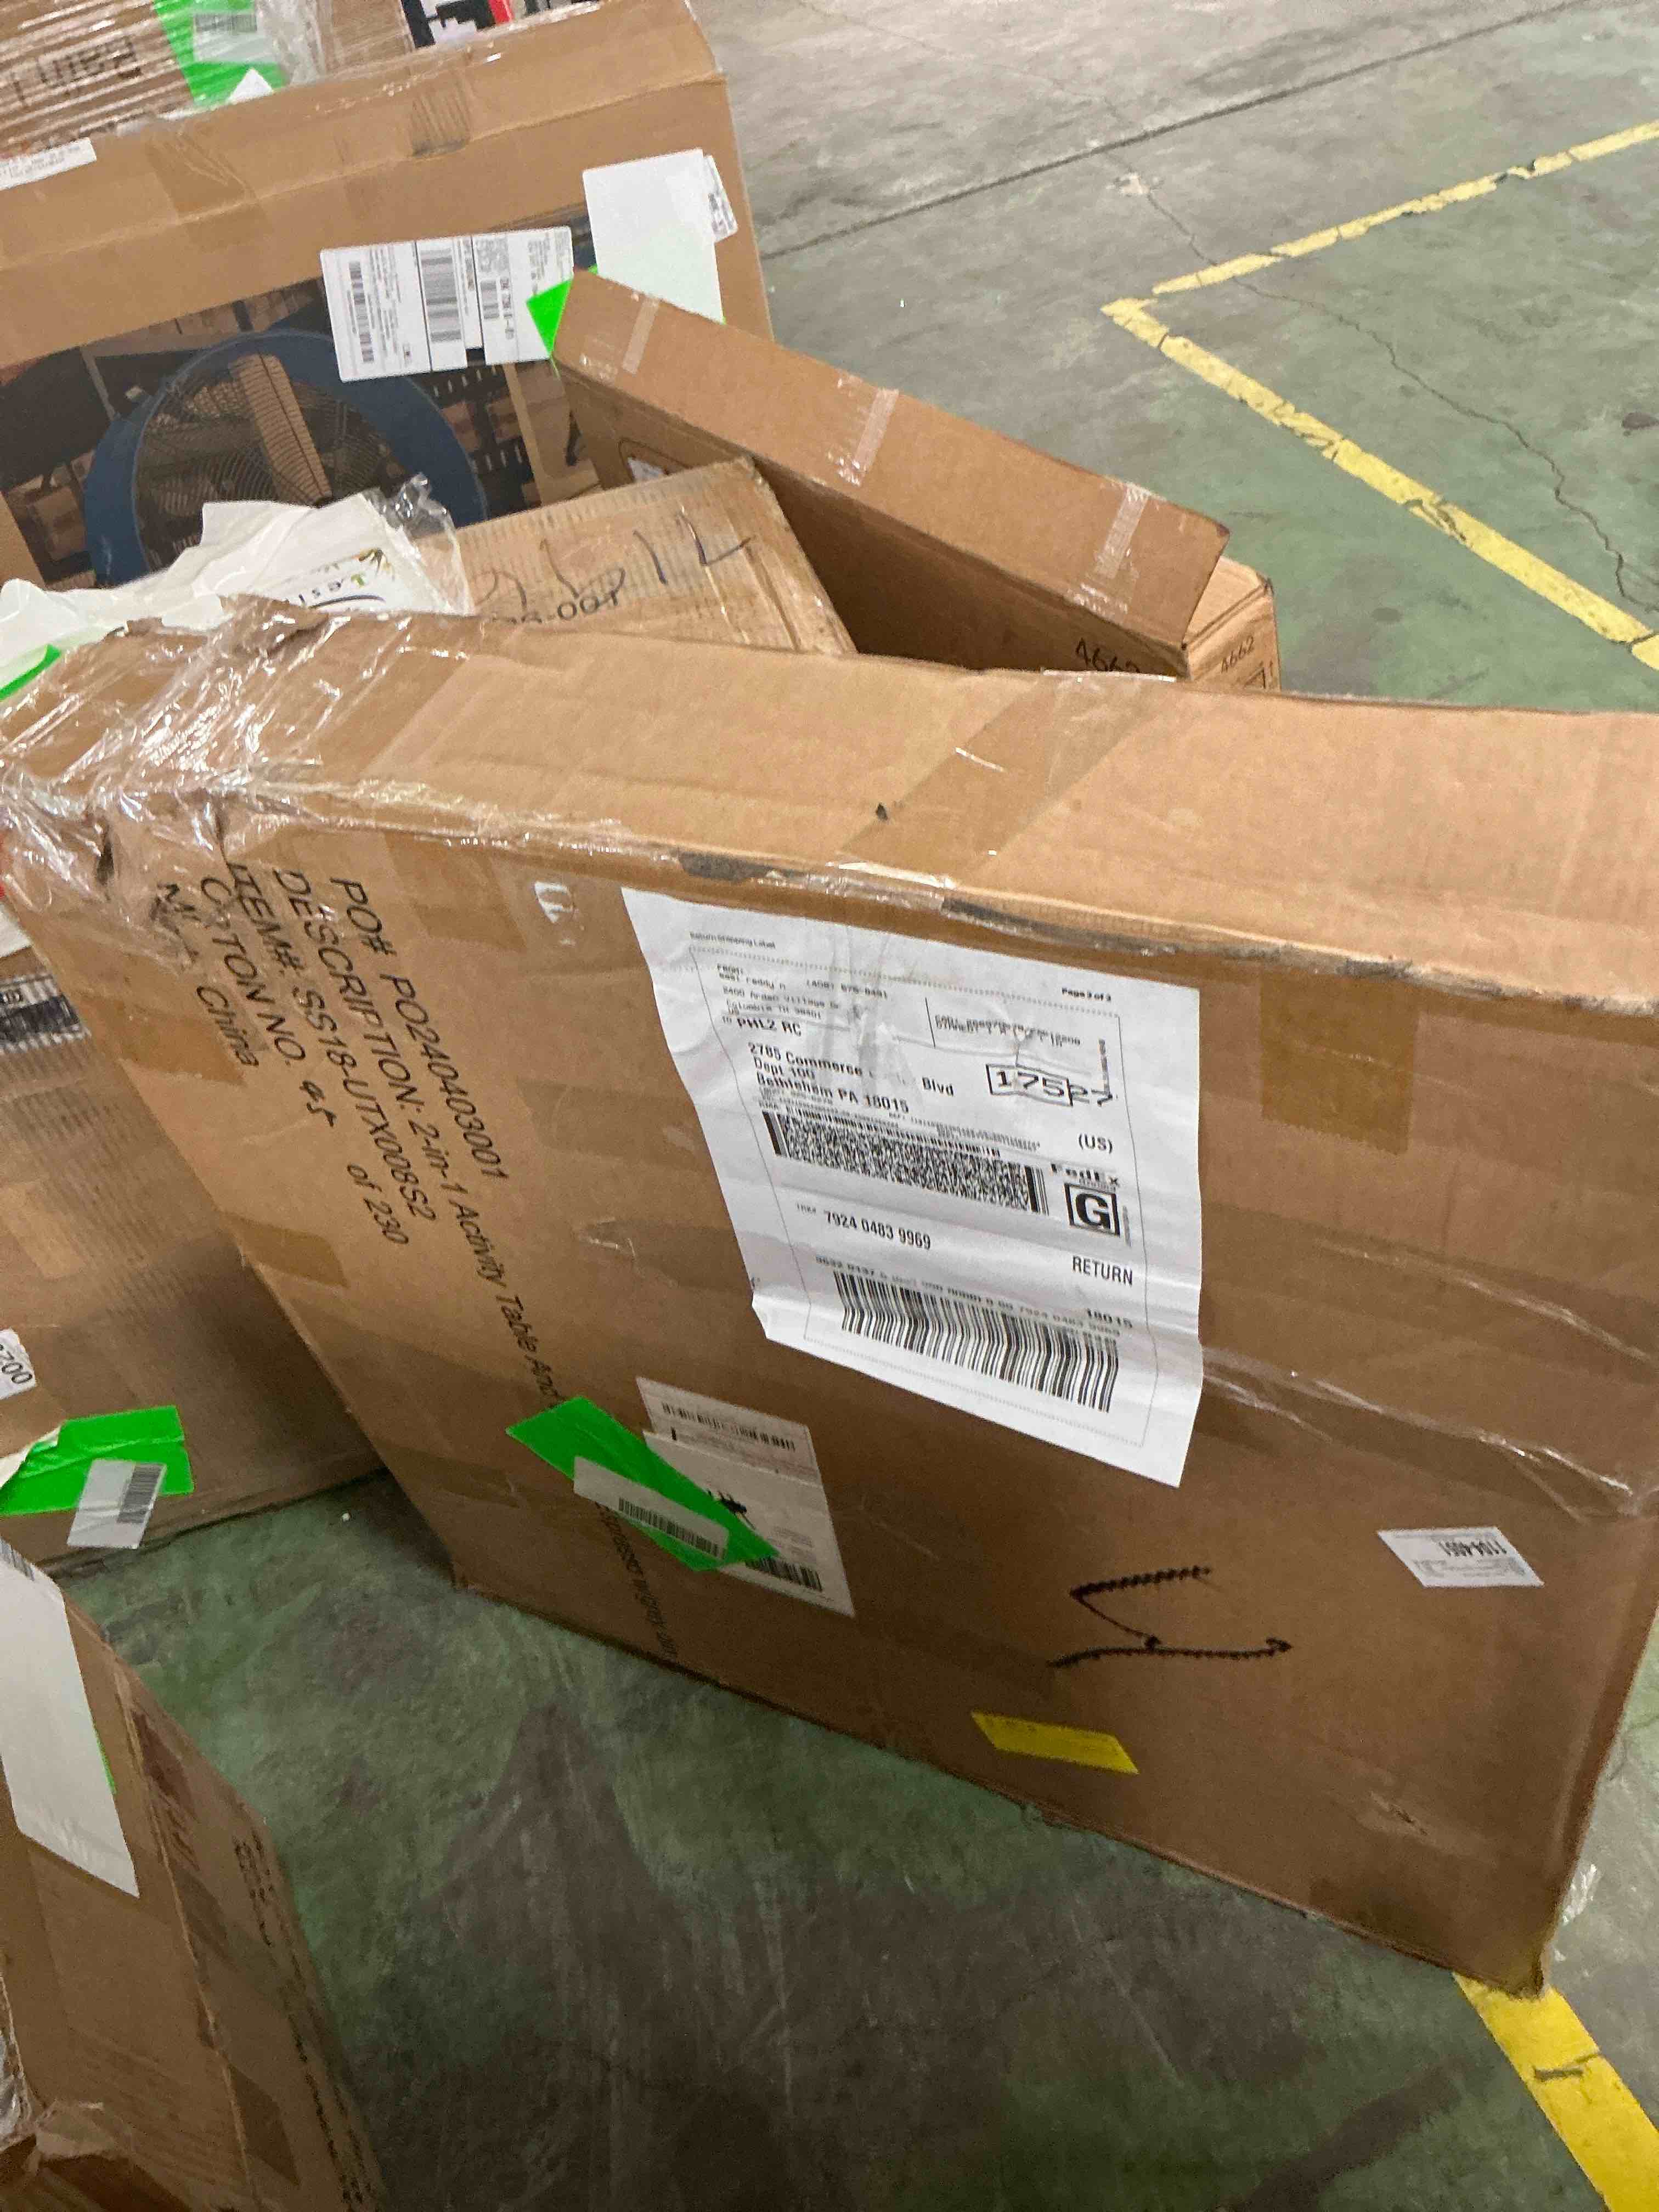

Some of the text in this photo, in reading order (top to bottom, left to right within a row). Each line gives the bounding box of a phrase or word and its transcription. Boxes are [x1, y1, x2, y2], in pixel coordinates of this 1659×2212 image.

[196, 986, 259, 1066] China
[330, 877, 509, 1179] PO# PO240403001
[838, 1088, 859, 1105] PA
[922, 1077, 953, 1097] Blvd
[273, 868, 425, 1113] DESCRIPTION:
[408, 1119, 468, 1193] 2-in-1
[448, 1198, 506, 1288] Activity
[496, 1294, 538, 1352] Table
[1079, 1133, 1113, 1154] (US)
[347, 1163, 409, 1245] of 230
[1075, 1193, 1111, 1229] G
[823, 1210, 857, 1229] 7924
[861, 1218, 894, 1240] 0483
[898, 1227, 931, 1250] 9969
[1073, 1255, 1133, 1286] RETURN
